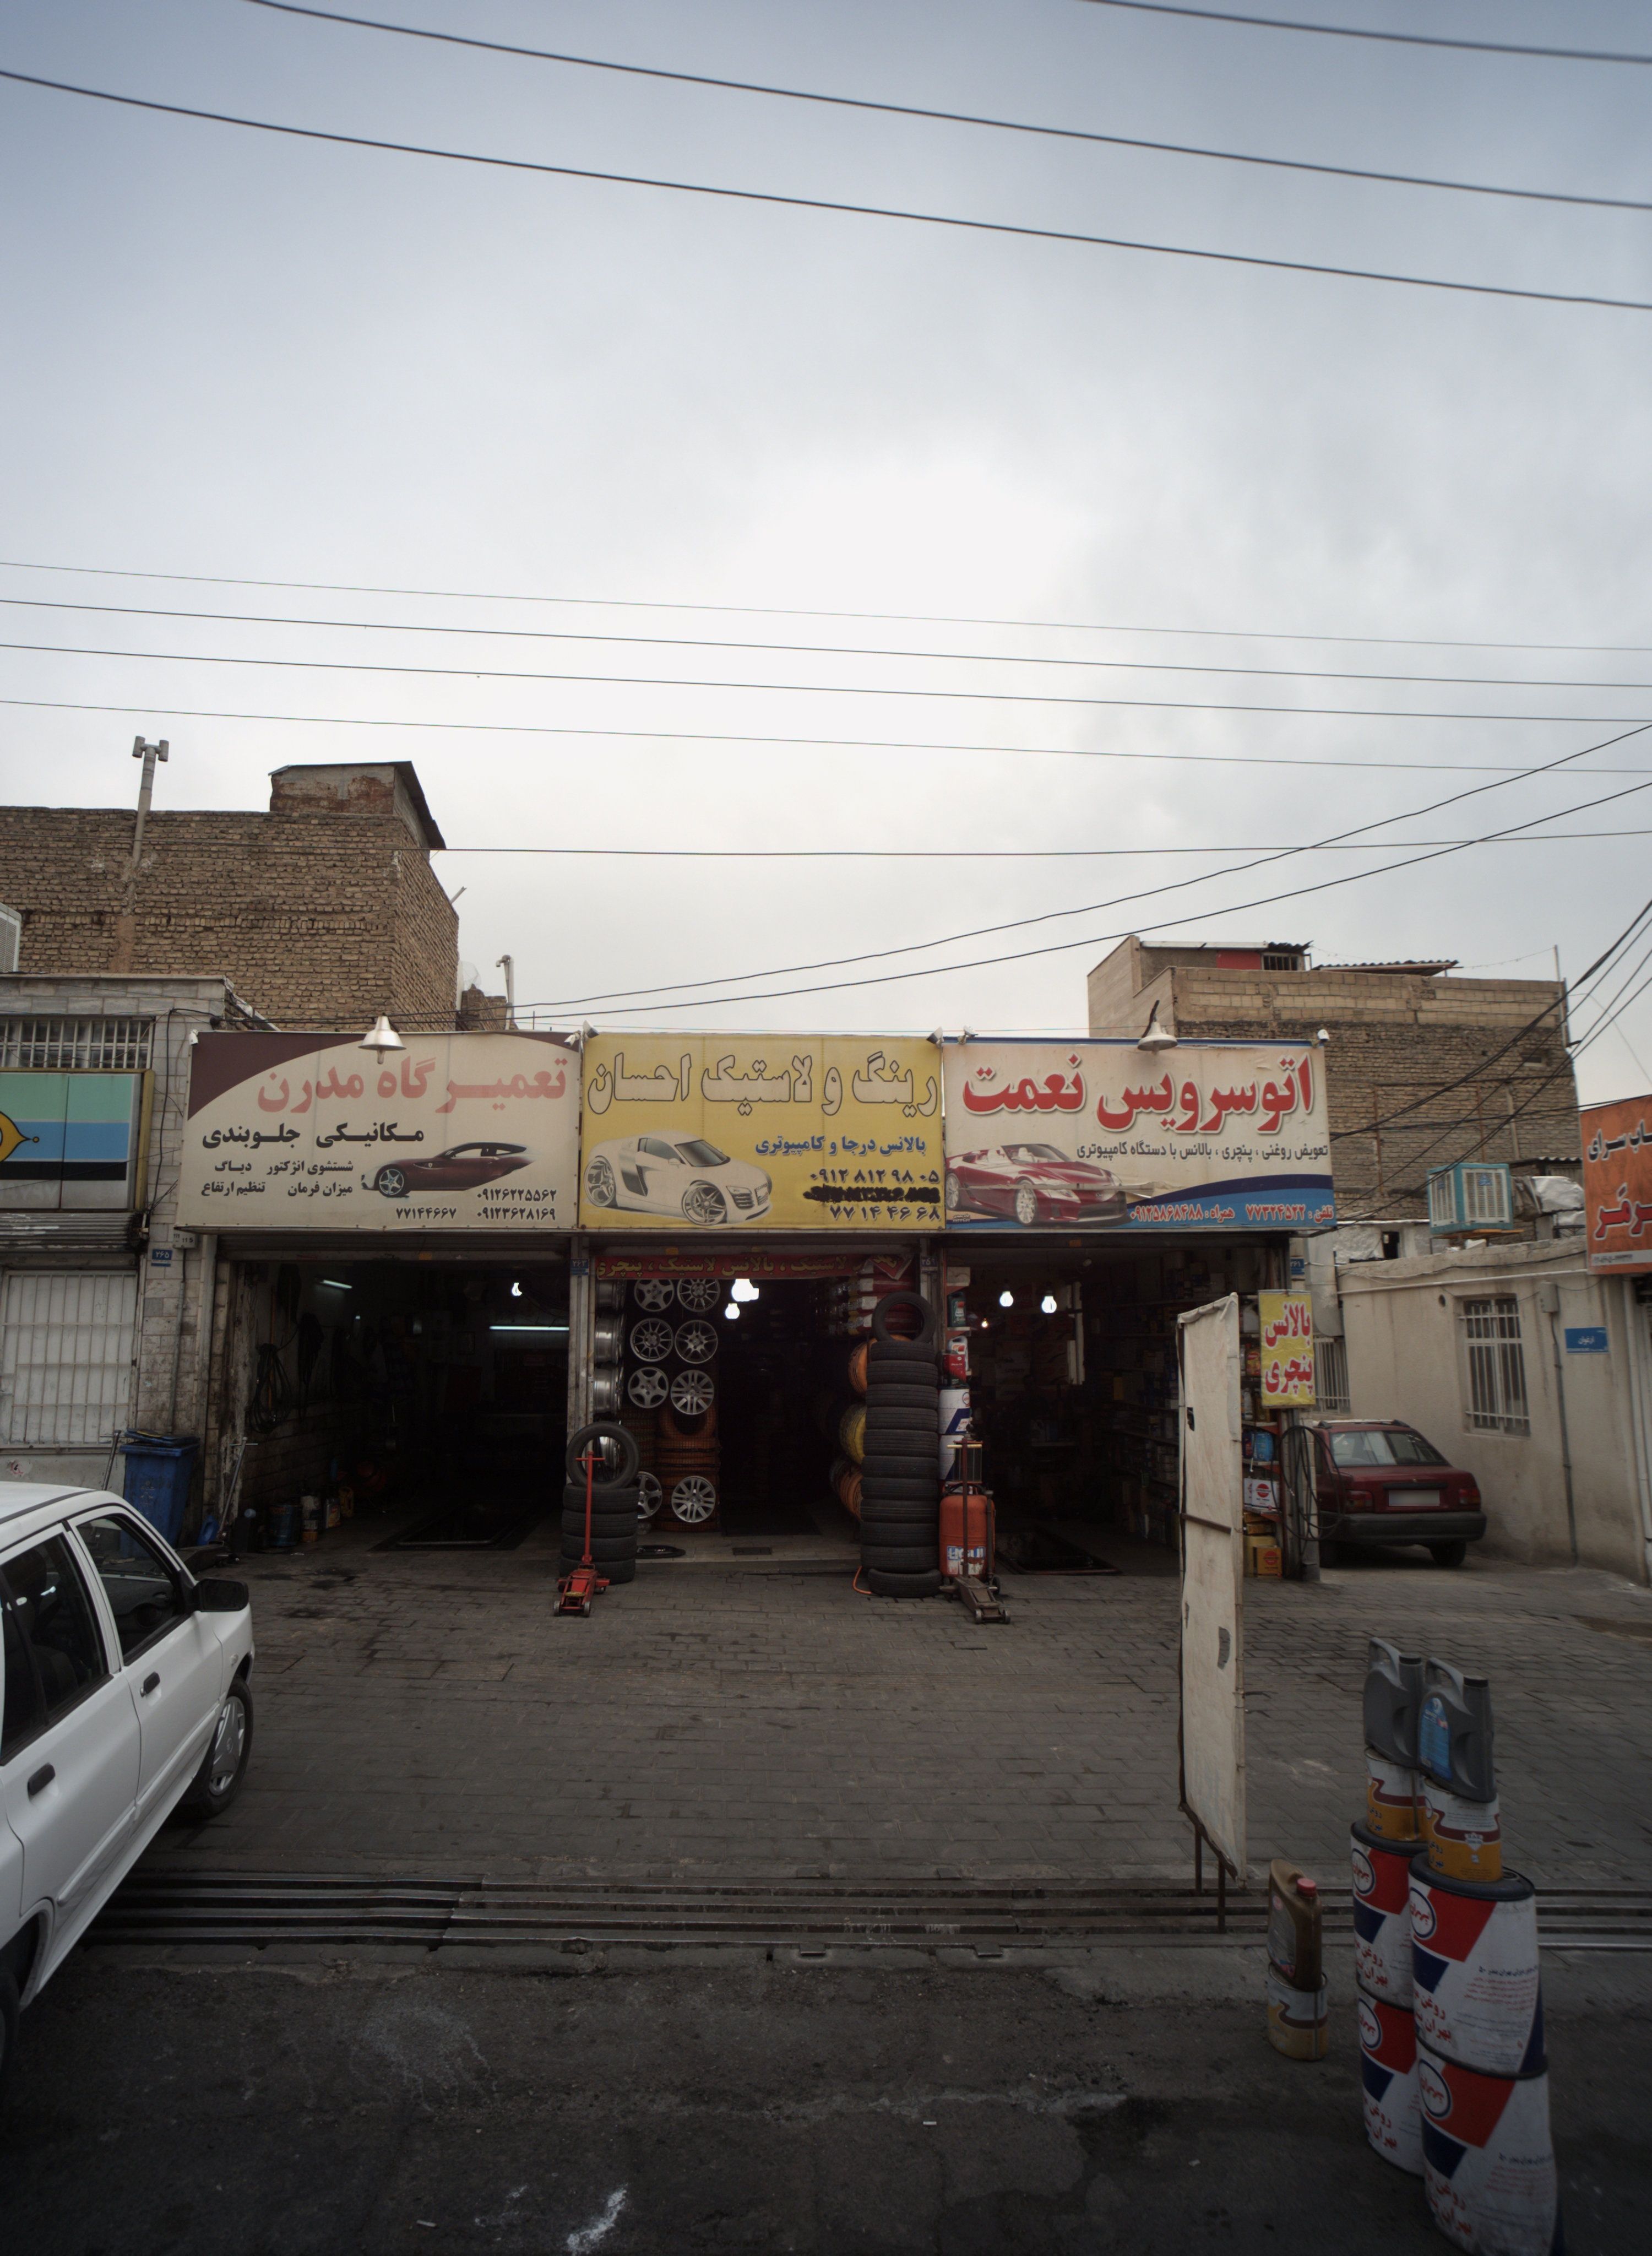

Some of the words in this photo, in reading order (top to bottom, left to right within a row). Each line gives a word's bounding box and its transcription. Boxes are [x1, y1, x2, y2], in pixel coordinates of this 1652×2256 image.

[258, 1065, 365, 1114] مدرن
[588, 1052, 692, 1115] احسان
[701, 1054, 813, 1116] لاستیک
[821, 1066, 843, 1116] و
[852, 1050, 938, 1118] رینگ
[962, 1052, 1087, 1114] نعمت
[202, 1122, 301, 1149] جلوبندی
[316, 1122, 424, 1148] مکانیکی
[755, 1135, 825, 1156] کامپیوتری
[828, 1141, 838, 1156] و
[841, 1136, 877, 1156] درجا
[879, 1136, 926, 1156] بالانس
[1077, 1141, 1128, 1162] کامپیوتری
[1131, 1140, 1167, 1156] دستگاه
[1170, 1142, 1177, 1159] با
[1180, 1142, 1212, 1160] بالانس
[1222, 1144, 1253, 1163] پنچری
[1262, 1143, 1292, 1160] روغنی
[1295, 1143, 1329, 1160] تعویض
[1588, 1128, 1627, 1163] سرای
[215, 1160, 252, 1174] دیاگ
[267, 1160, 305, 1175] انژکتور
[307, 1160, 354, 1175] شستشوی
[810, 1168, 849, 1183] ۰۹۱۲
[854, 1168, 885, 1184] ۸۱۲
[891, 1169, 914, 1184] ۹۸
[919, 1169, 940, 1184] ۰۵
[201, 1181, 235, 1196] ارتفاع
[236, 1181, 266, 1196] تنظیم
[287, 1181, 320, 1196] فرمان
[323, 1181, 353, 1196] میزان
[829, 1205, 855, 1221] ۷۷
[658, 1256, 717, 1276] لاستیک
[721, 1255, 774, 1277] بالانس
[1265, 1303, 1311, 1347] بالانس
[1265, 1354, 1313, 1395] پنچری
